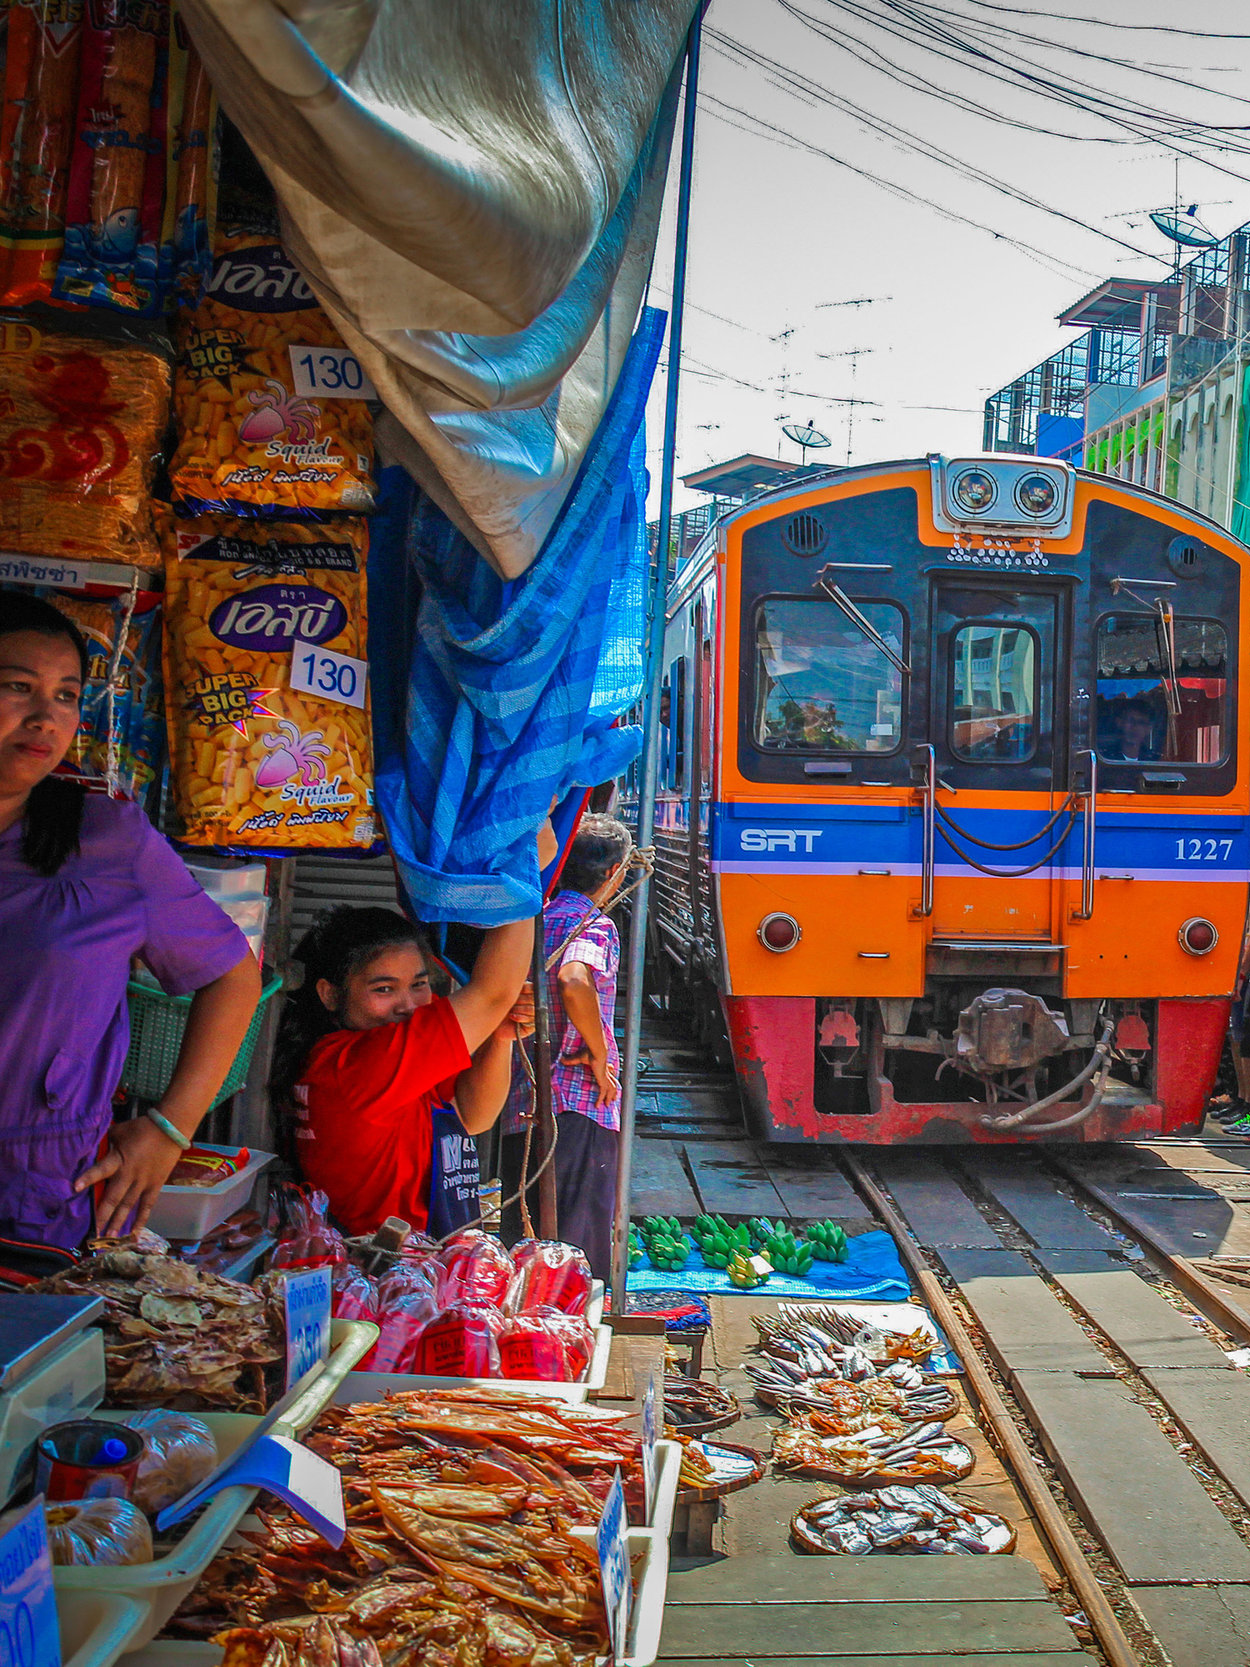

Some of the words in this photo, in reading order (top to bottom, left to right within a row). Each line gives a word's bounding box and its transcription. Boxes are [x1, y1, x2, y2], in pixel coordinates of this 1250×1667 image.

[191, 345, 233, 367] BIG
[299, 354, 364, 390] 130
[265, 436, 330, 464] Squid
[218, 598, 335, 637] เอสบี
[184, 672, 260, 699] SUPER
[302, 652, 357, 698] 130
[201, 689, 247, 713] BIG
[198, 706, 255, 726] PACK
[280, 776, 340, 806] Squid
[309, 793, 355, 805] Flavour
[740, 828, 823, 853] SRT
[1175, 838, 1234, 861] 1227
